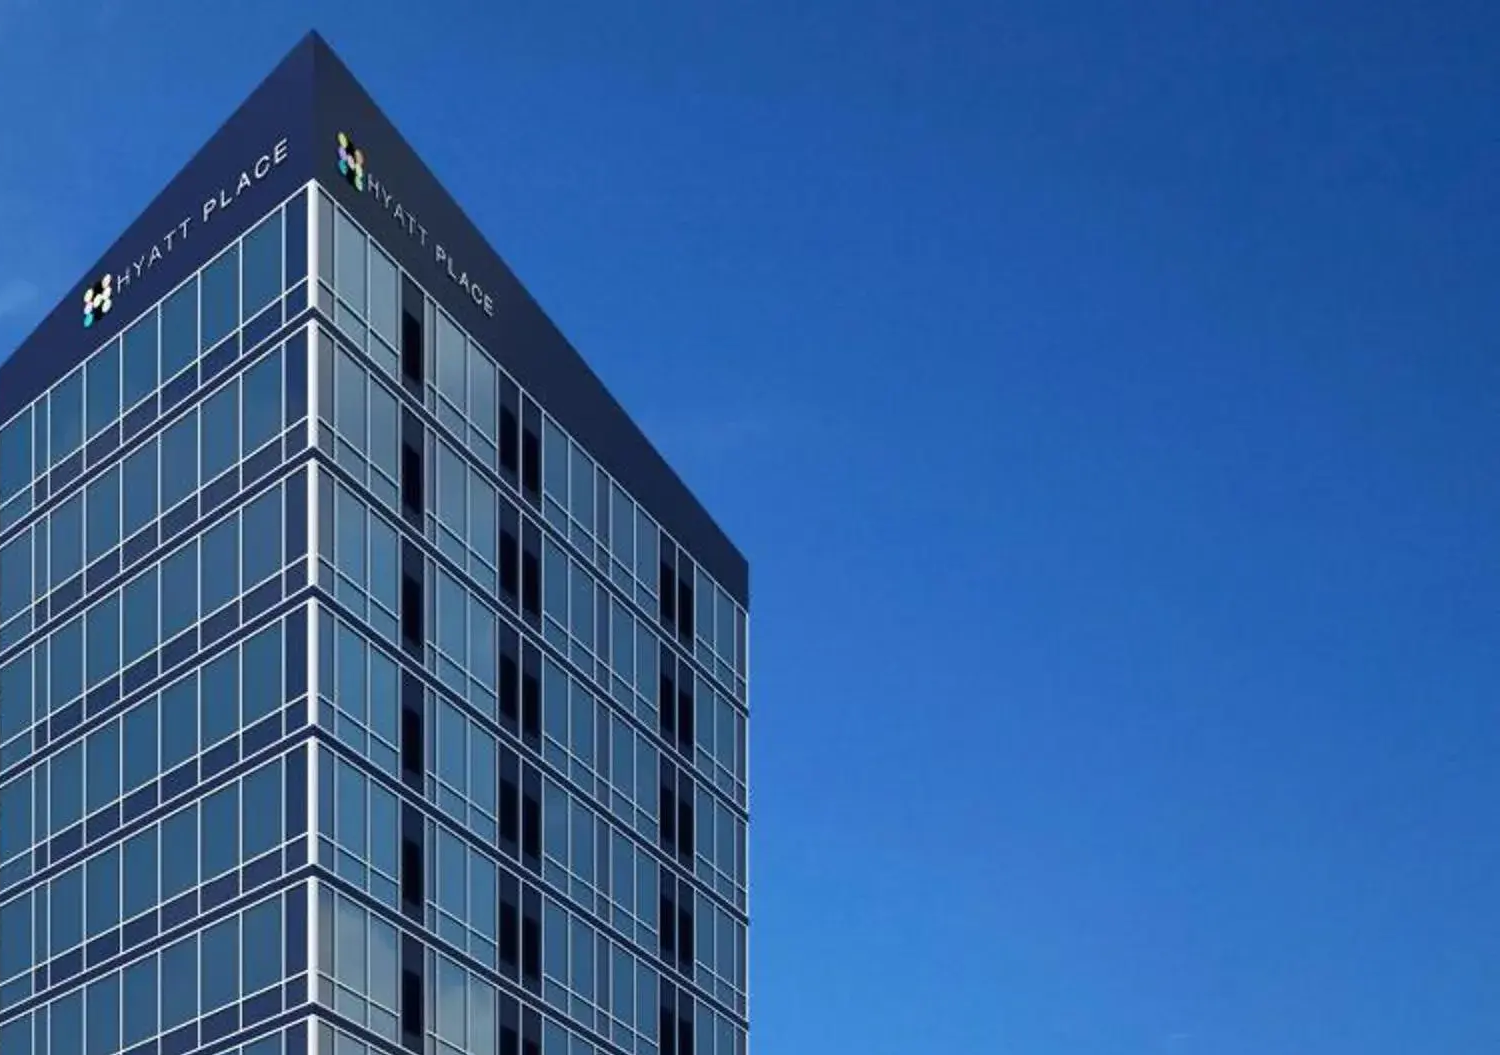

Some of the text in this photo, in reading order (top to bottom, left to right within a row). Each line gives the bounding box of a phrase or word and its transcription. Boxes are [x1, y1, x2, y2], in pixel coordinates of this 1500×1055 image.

[116, 138, 288, 293] HYATT PLACE
[367, 173, 494, 317] HYATT PLACE
